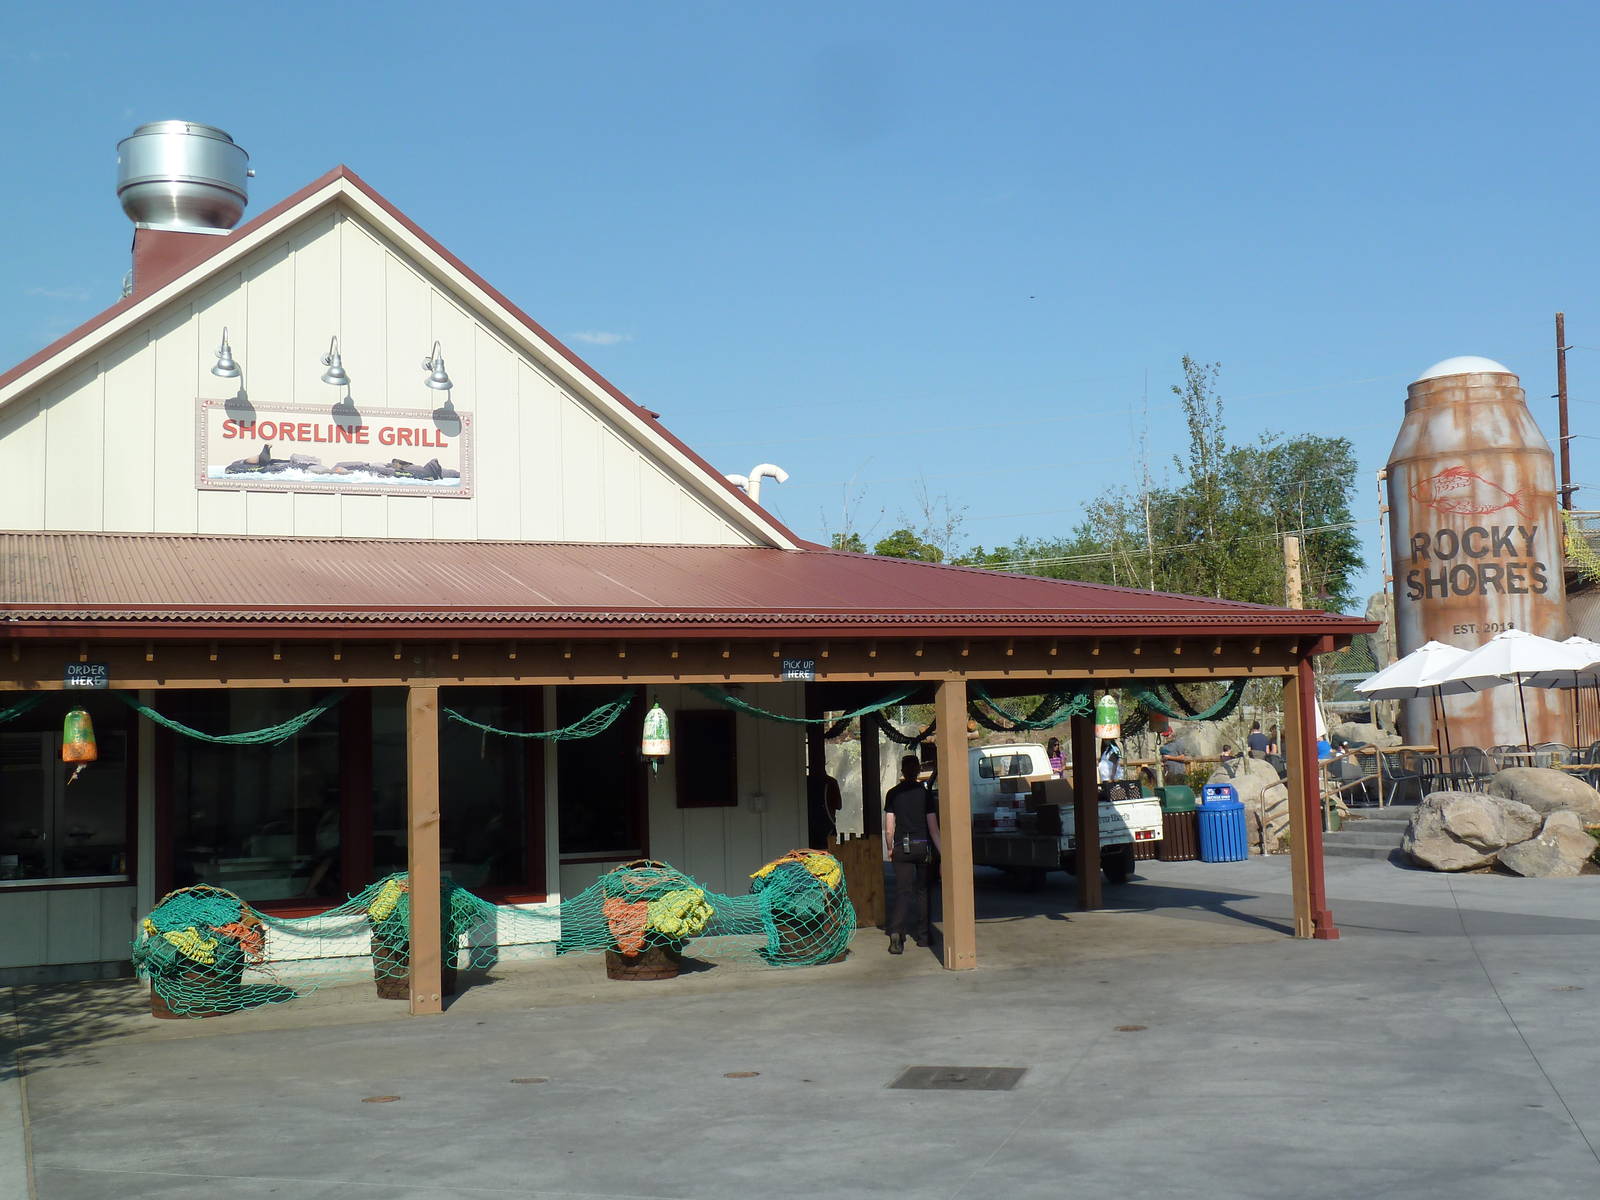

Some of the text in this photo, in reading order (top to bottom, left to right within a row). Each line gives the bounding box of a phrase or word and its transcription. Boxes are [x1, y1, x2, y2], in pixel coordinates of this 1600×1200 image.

[222, 419, 449, 448] SHORELINE GRILL
[1410, 525, 1538, 565] ROCKY
[1406, 562, 1548, 602] SHORES
[1453, 624, 1479, 635] EST.
[803, 660, 814, 669] UP
[67, 665, 105, 675] ORDER
[788, 670, 810, 678] HERE
[71, 676, 102, 686] HERE
